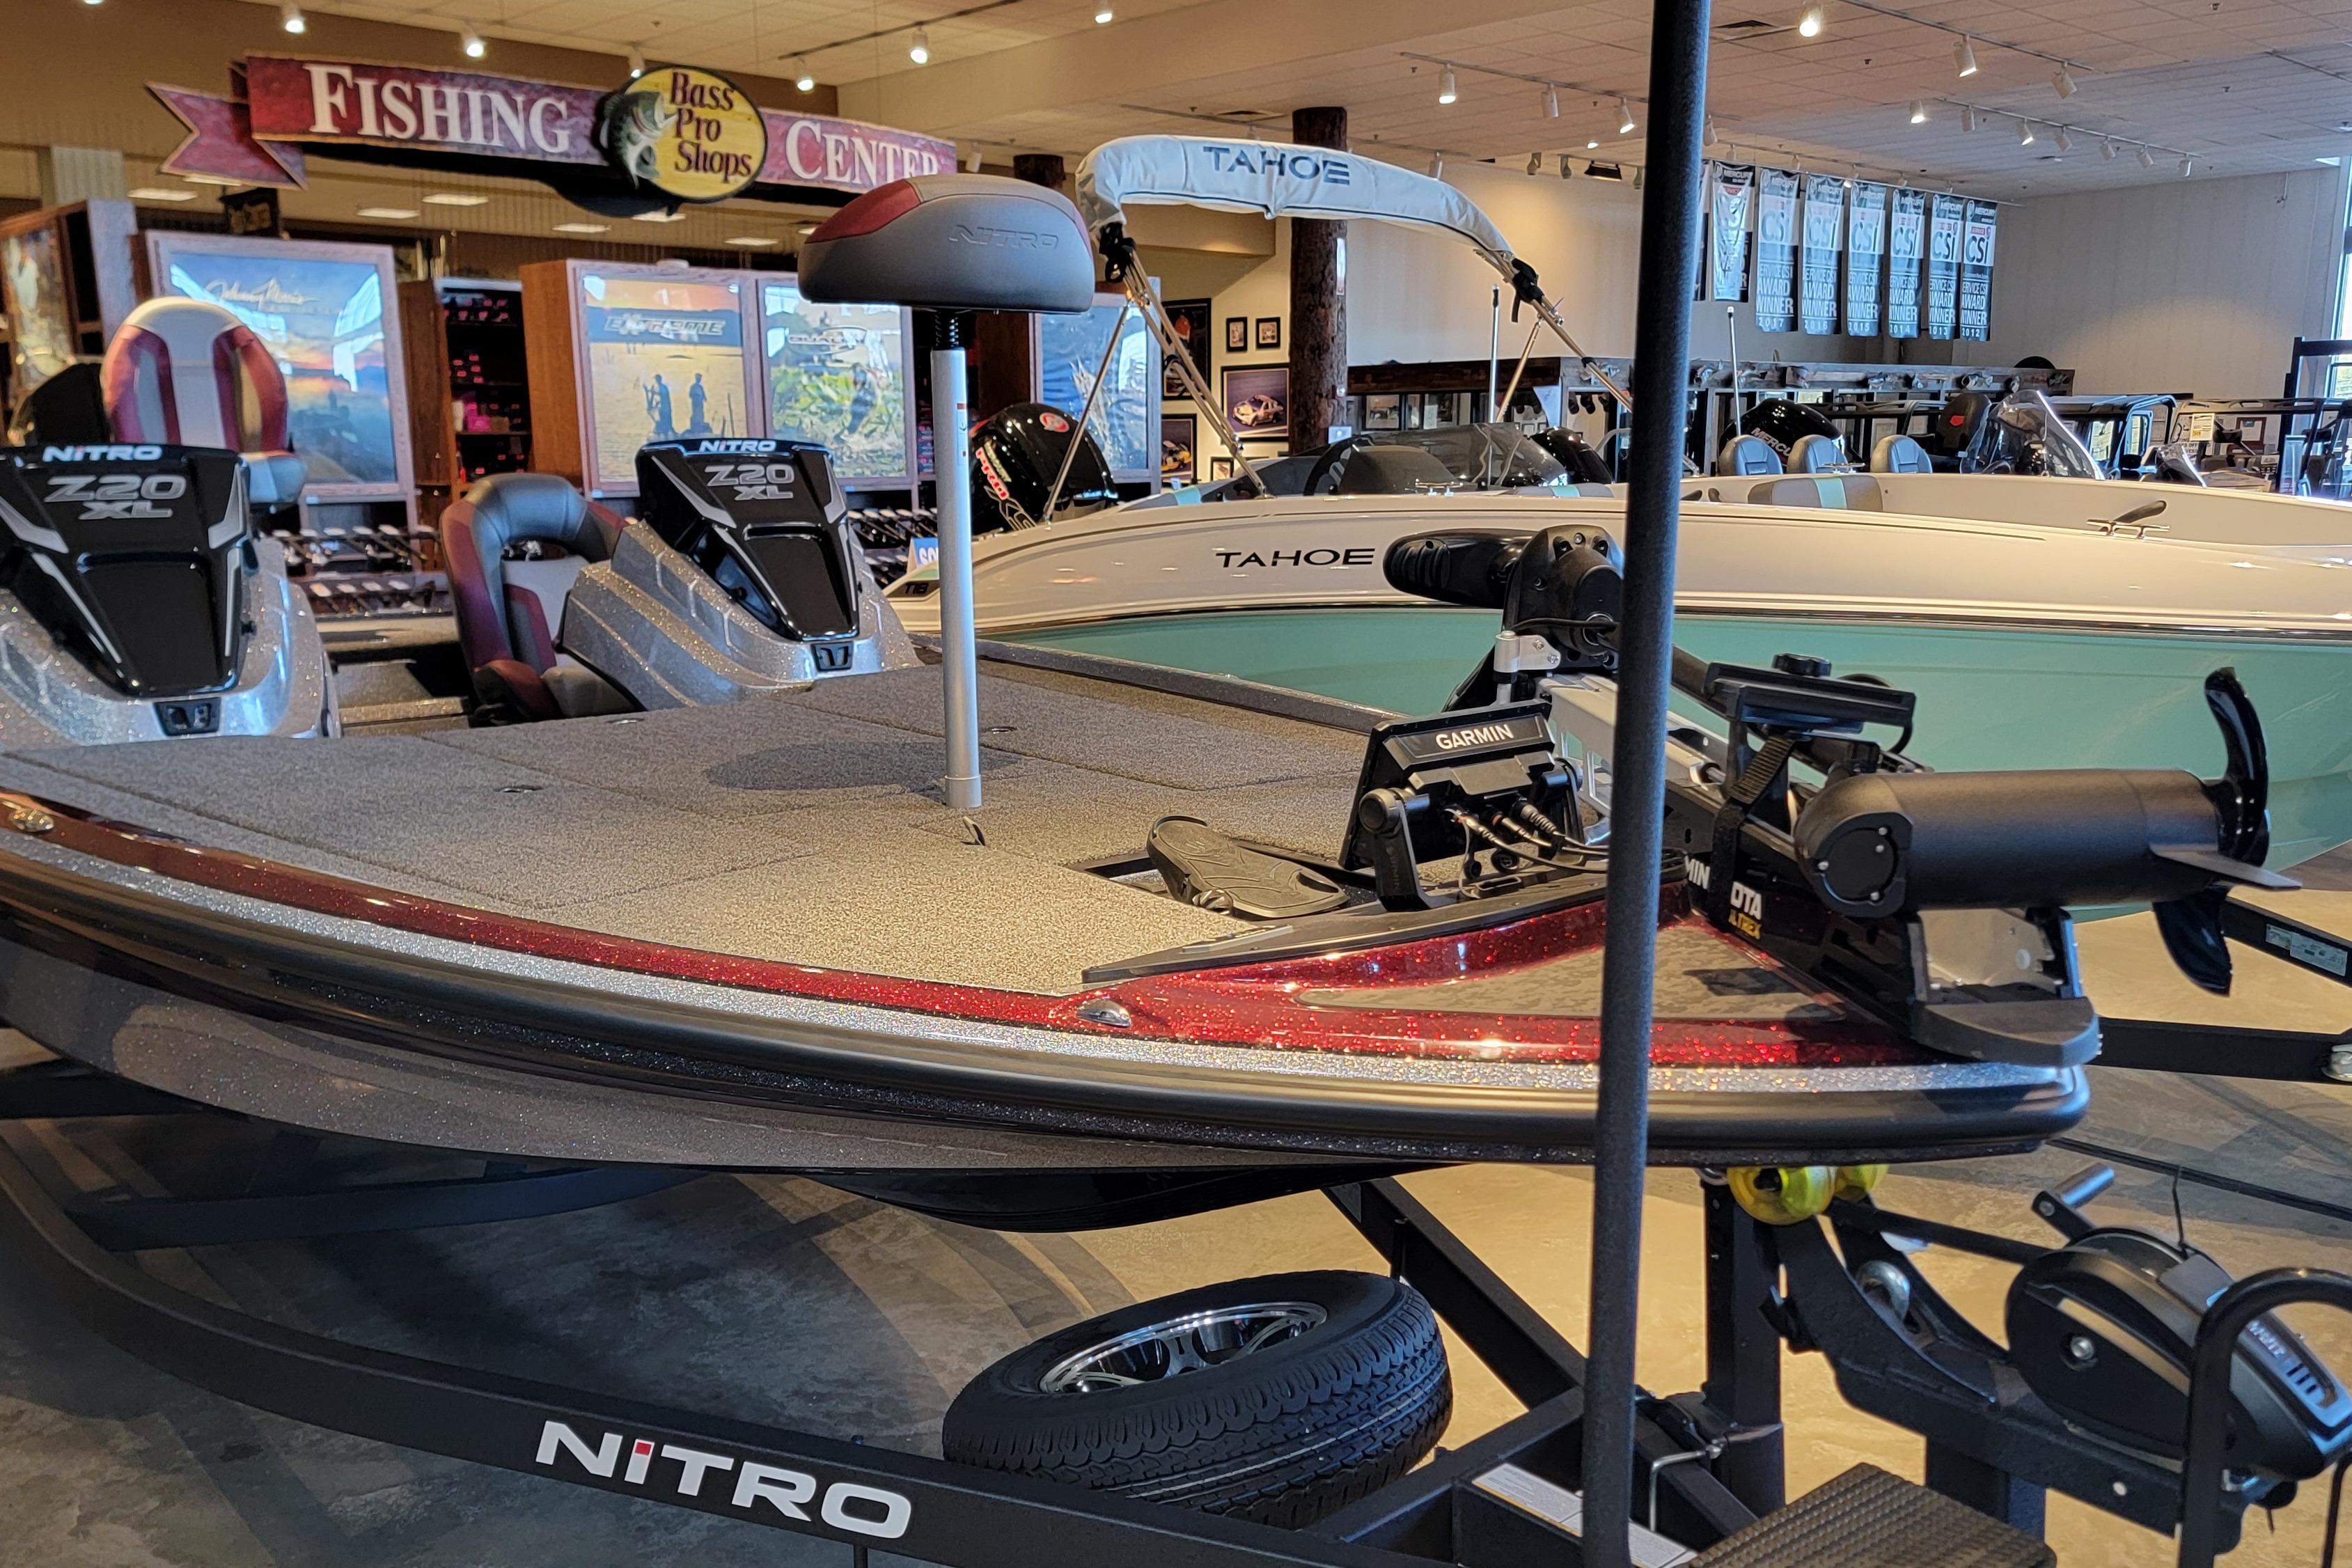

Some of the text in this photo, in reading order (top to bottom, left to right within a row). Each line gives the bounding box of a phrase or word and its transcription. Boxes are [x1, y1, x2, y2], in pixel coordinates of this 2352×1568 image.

[671, 72, 735, 111] Bass
[303, 64, 570, 152] FISHING
[675, 107, 721, 141] Pro
[675, 140, 753, 183] Shops
[1202, 146, 1350, 185] TAHOE
[1759, 317, 1784, 328] 2017
[1805, 320, 1828, 330] 2016
[1849, 322, 1870, 331] 2015
[1890, 324, 1911, 334] 2014
[1929, 326, 1947, 335] 2013
[1962, 327, 1980, 337] 2012
[1750, 427, 1794, 457] MERCU
[704, 463, 795, 487] Z20
[44, 474, 187, 503] Z20
[732, 485, 794, 501] XL
[78, 500, 173, 520] XL
[1215, 548, 1376, 568] TAHOE
[1435, 723, 1514, 750] GARMIN
[1684, 855, 1762, 920] MIN OTA
[536, 1420, 911, 1539] NITRO
